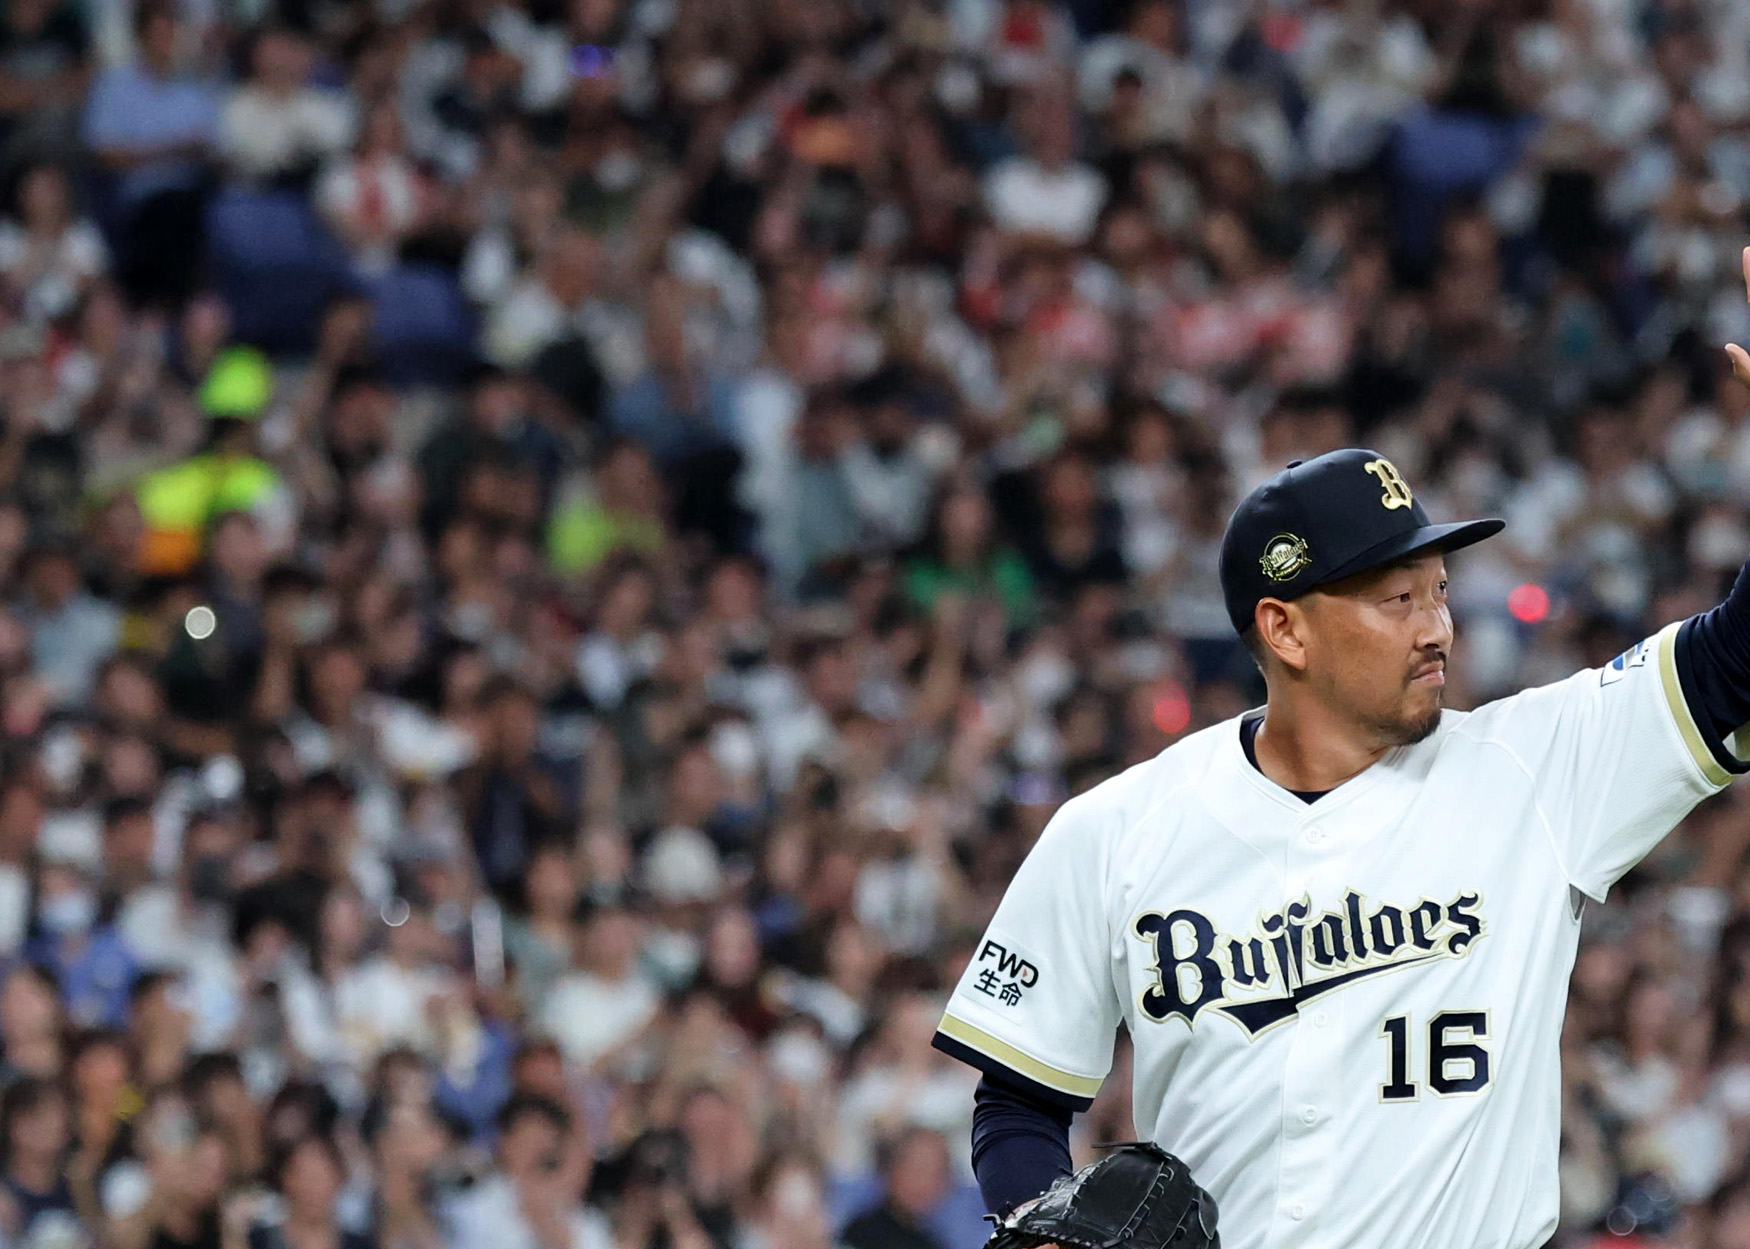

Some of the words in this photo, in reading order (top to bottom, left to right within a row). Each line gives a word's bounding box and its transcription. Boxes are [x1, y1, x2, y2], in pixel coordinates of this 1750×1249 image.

[1364, 458, 1414, 510] B
[973, 968, 1023, 1007] 生命
[978, 939, 1039, 989] FWD
[1131, 886, 1488, 1037] Buffaloes
[1378, 1008, 1495, 1104] 16
